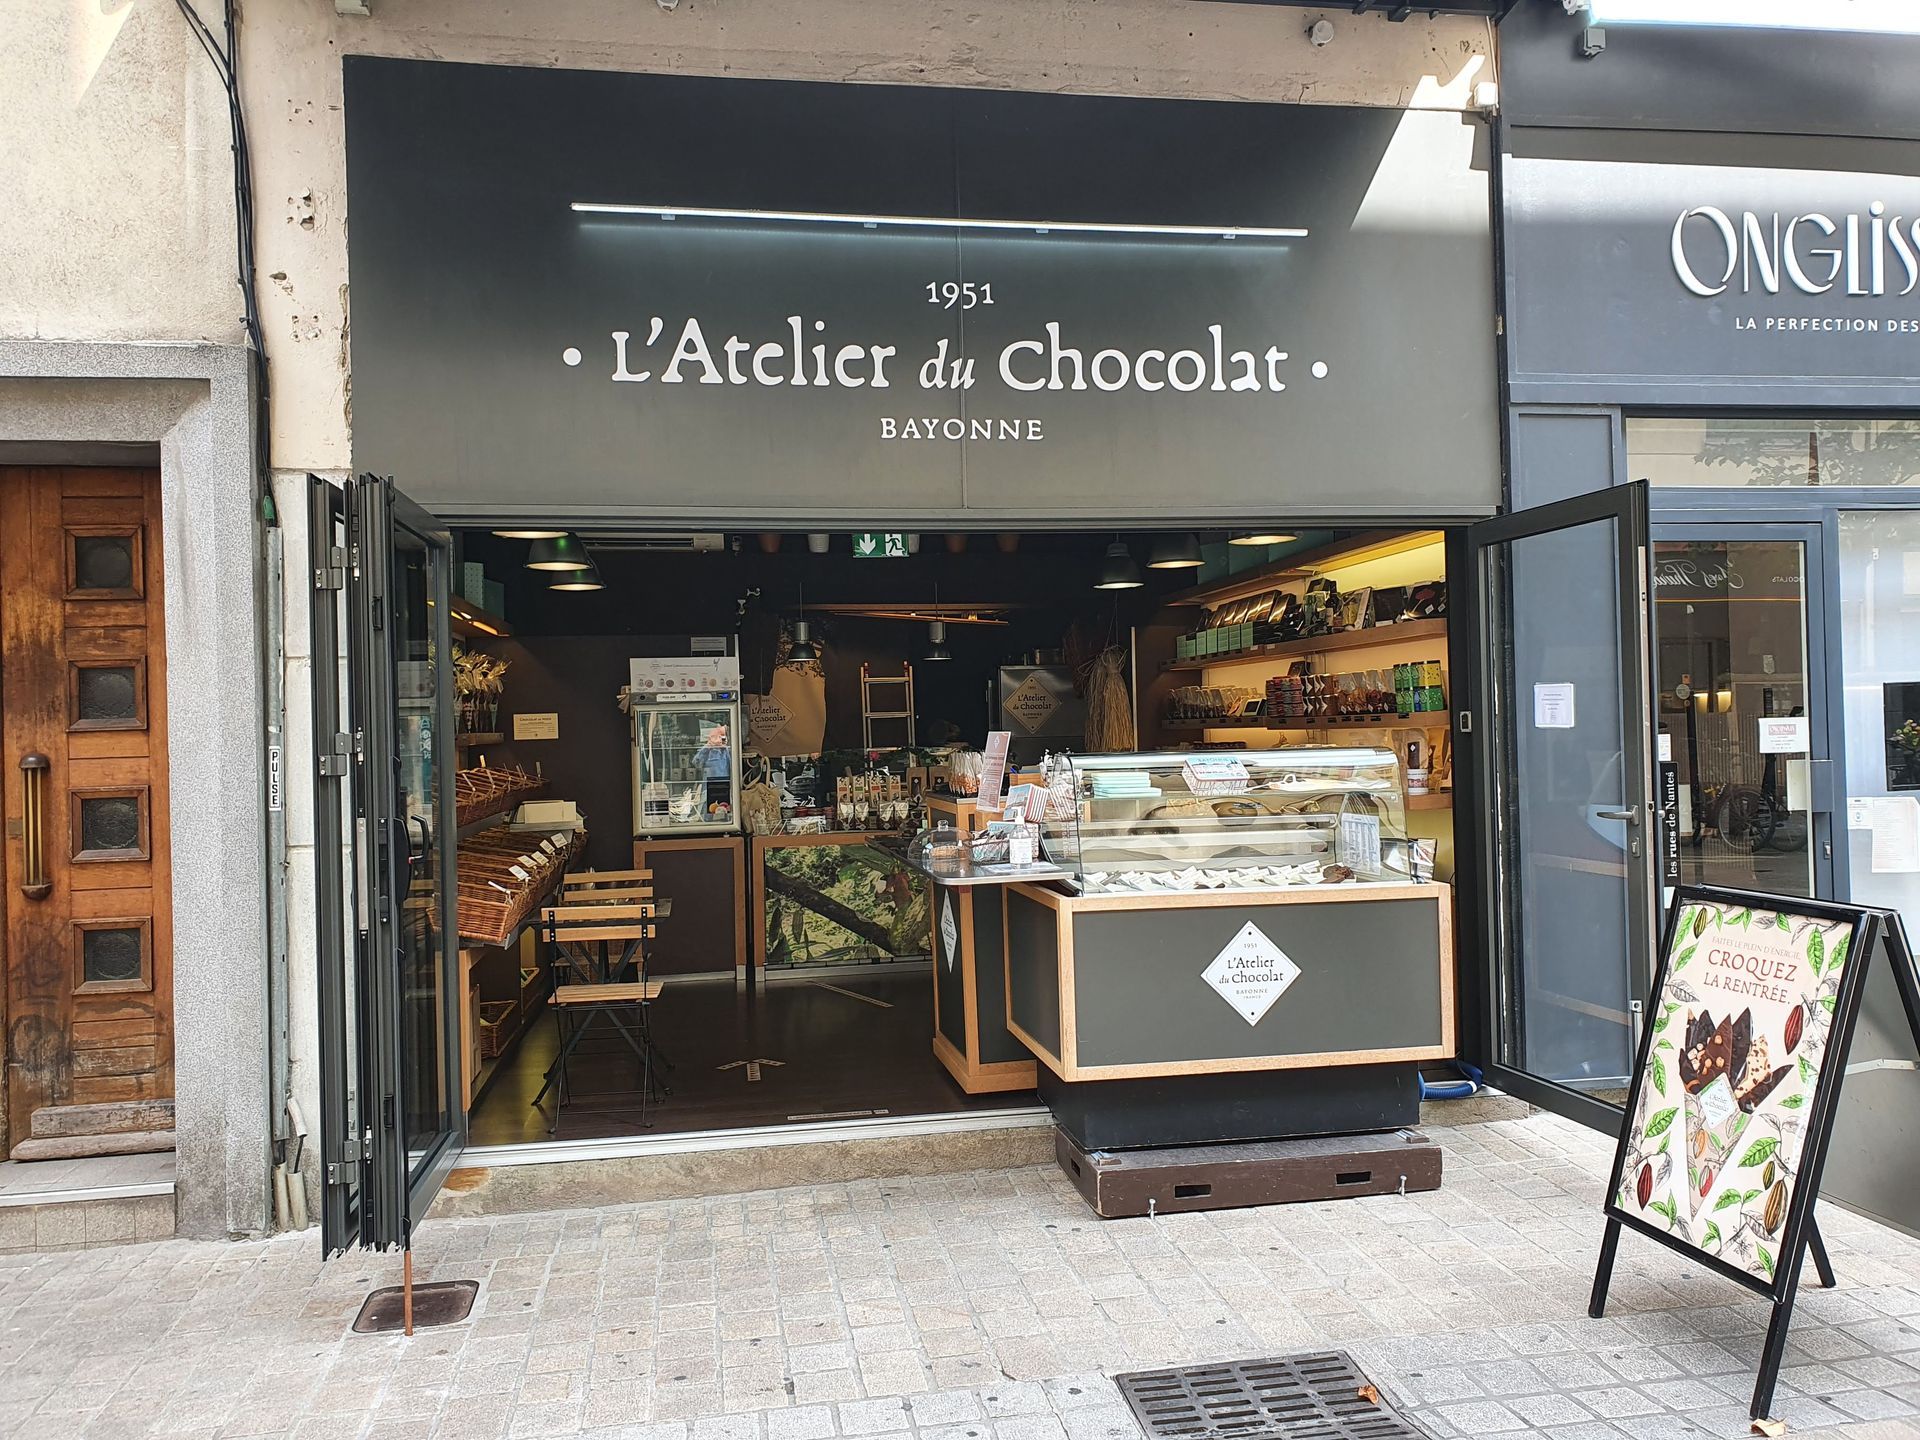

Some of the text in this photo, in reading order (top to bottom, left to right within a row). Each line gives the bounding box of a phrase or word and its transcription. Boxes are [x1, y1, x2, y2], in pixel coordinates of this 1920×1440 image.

[925, 281, 995, 310] 1951
[1735, 316, 1920, 334] LA PERFECTION DES
[610, 315, 1289, 393] L'Atelier du Chocolat
[880, 416, 1045, 441] BAYONNE
[271, 752, 279, 804] PULSE
[1665, 771, 1676, 810] Nantes
[1665, 813, 1676, 829] de
[1669, 831, 1677, 857] rues
[1667, 861, 1678, 877] les
[1227, 955, 1275, 970] L'Atelier
[1708, 949, 1798, 982] CROQUEZ
[1218, 969, 1285, 985] du Chocolat
[1703, 972, 1791, 1005] LA RENTRÉE.
